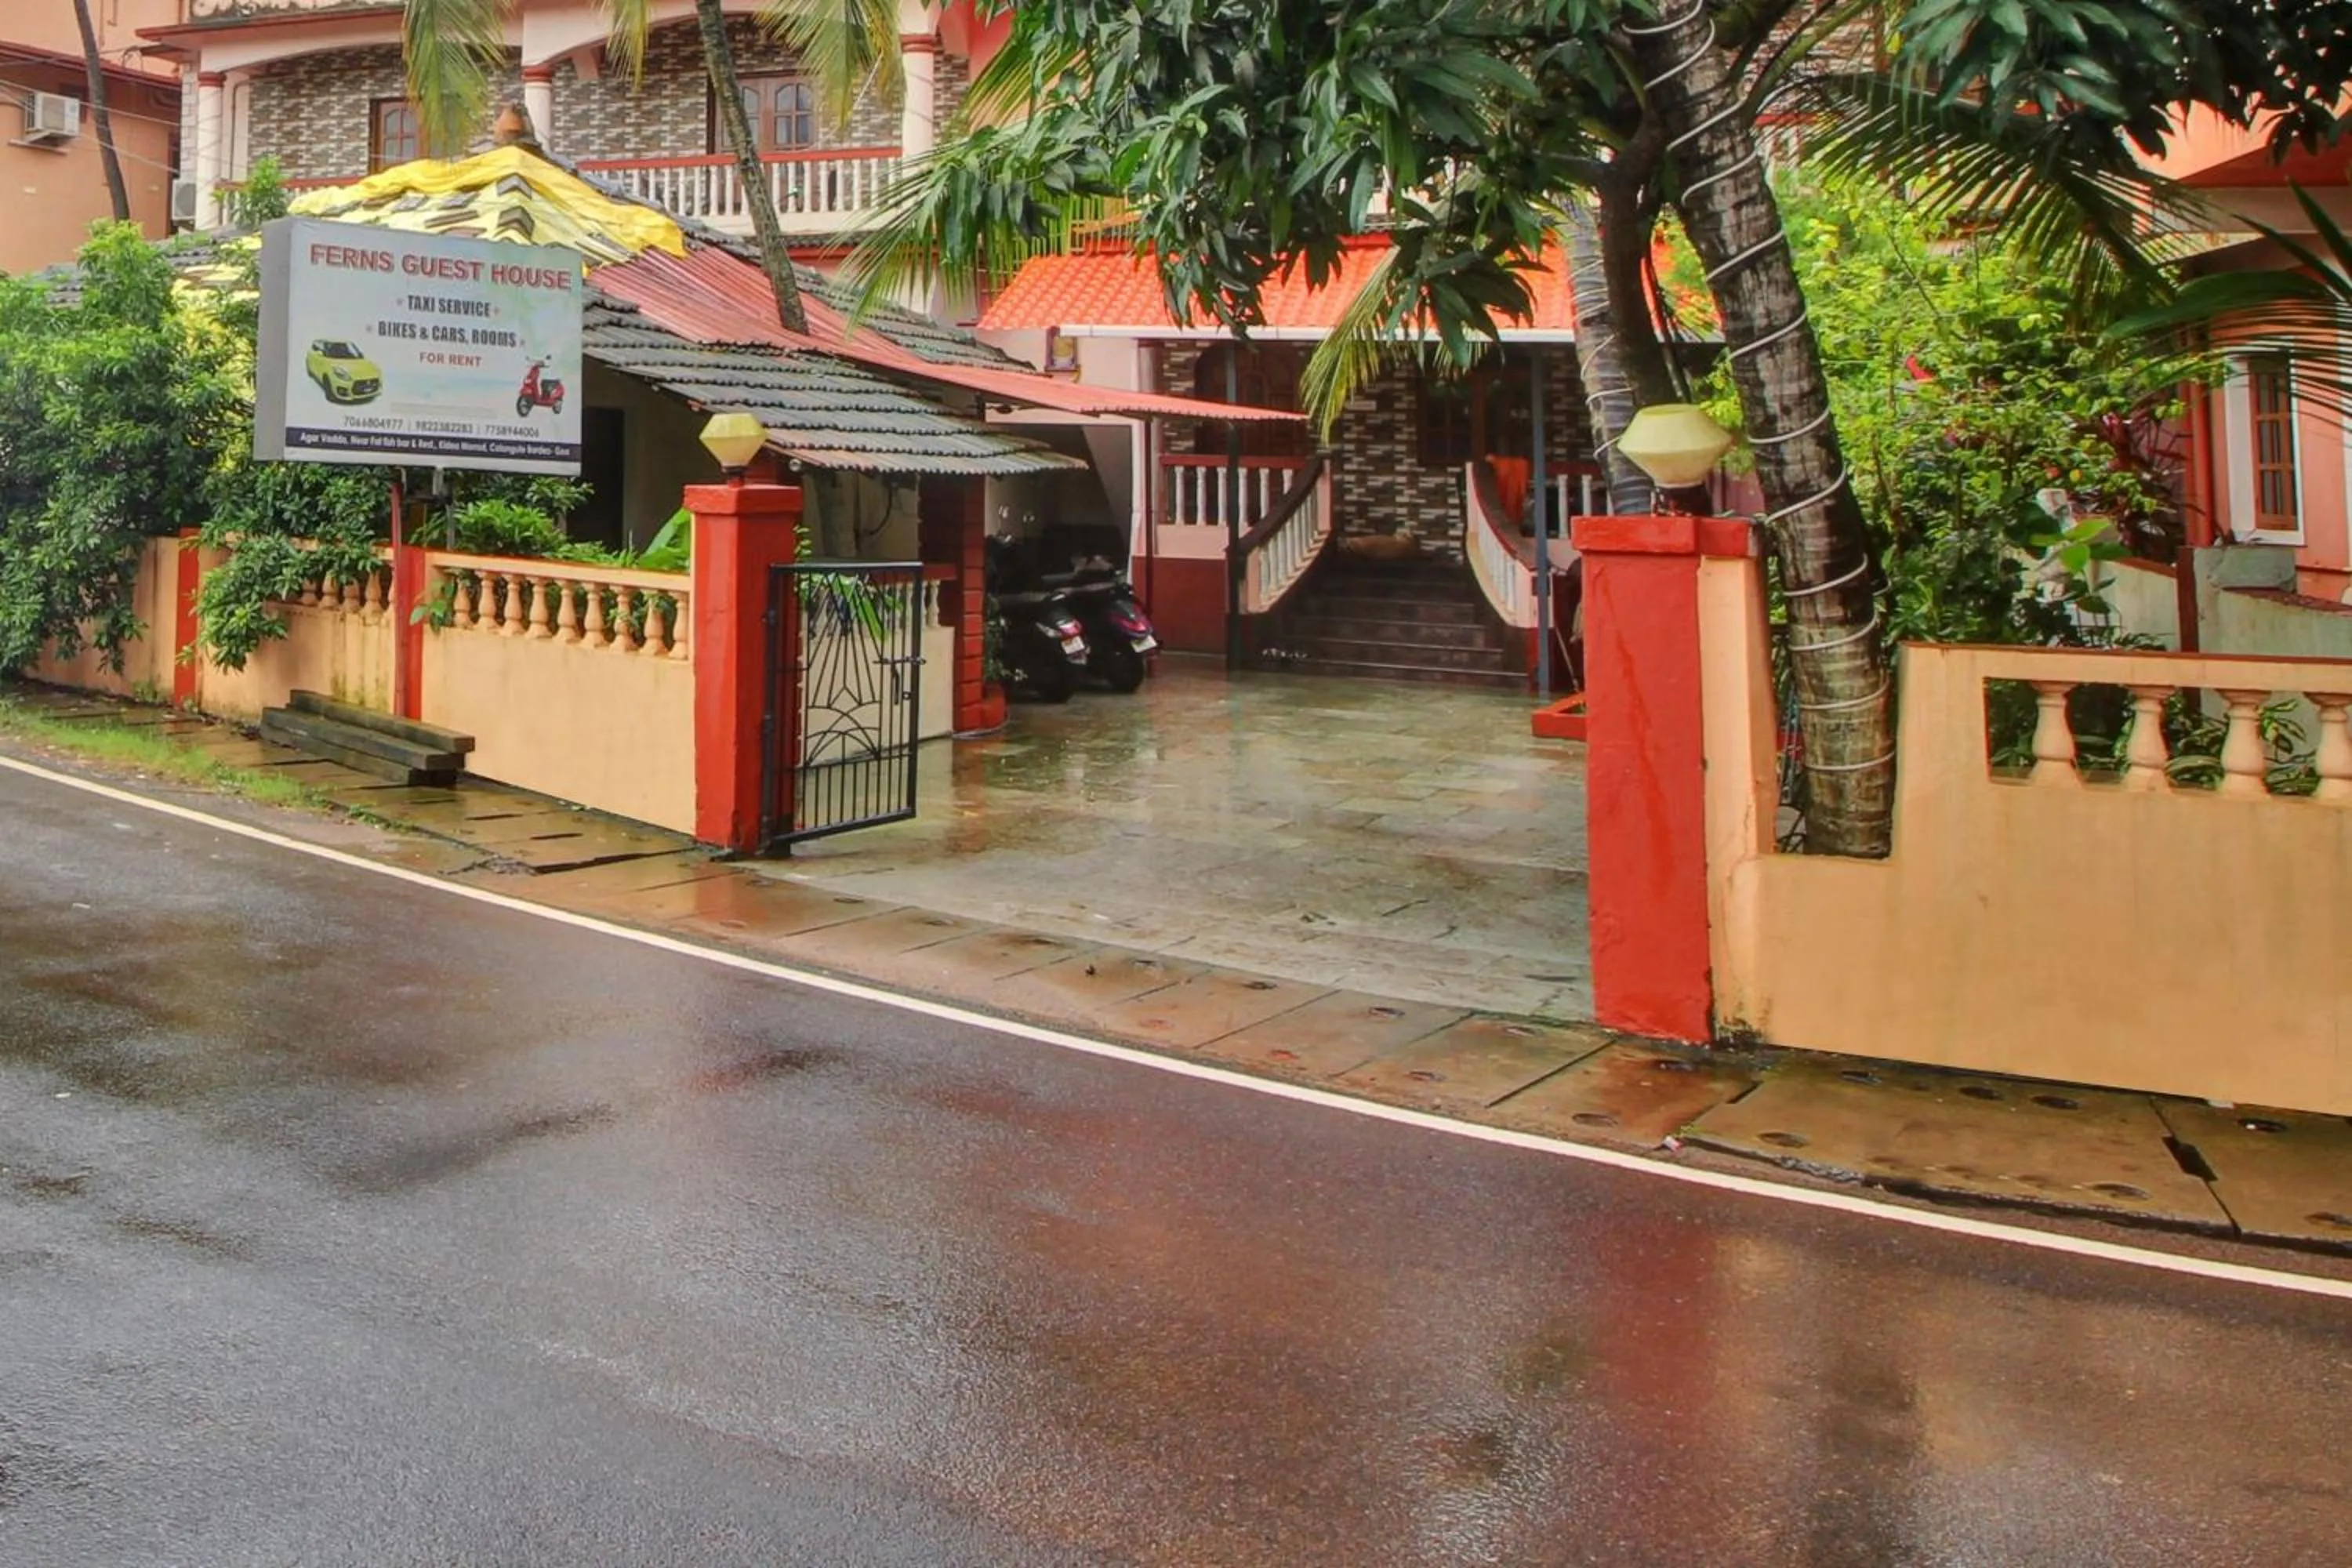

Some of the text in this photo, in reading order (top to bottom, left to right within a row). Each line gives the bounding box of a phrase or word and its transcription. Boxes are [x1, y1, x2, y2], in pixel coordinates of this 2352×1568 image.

[310, 244, 572, 290] FERNS GUEST HOUSE
[407, 295, 492, 317] TAXI SERVICE
[378, 321, 517, 347] BIKES & CARS, ROOMS
[419, 352, 481, 368] FOR RENT
